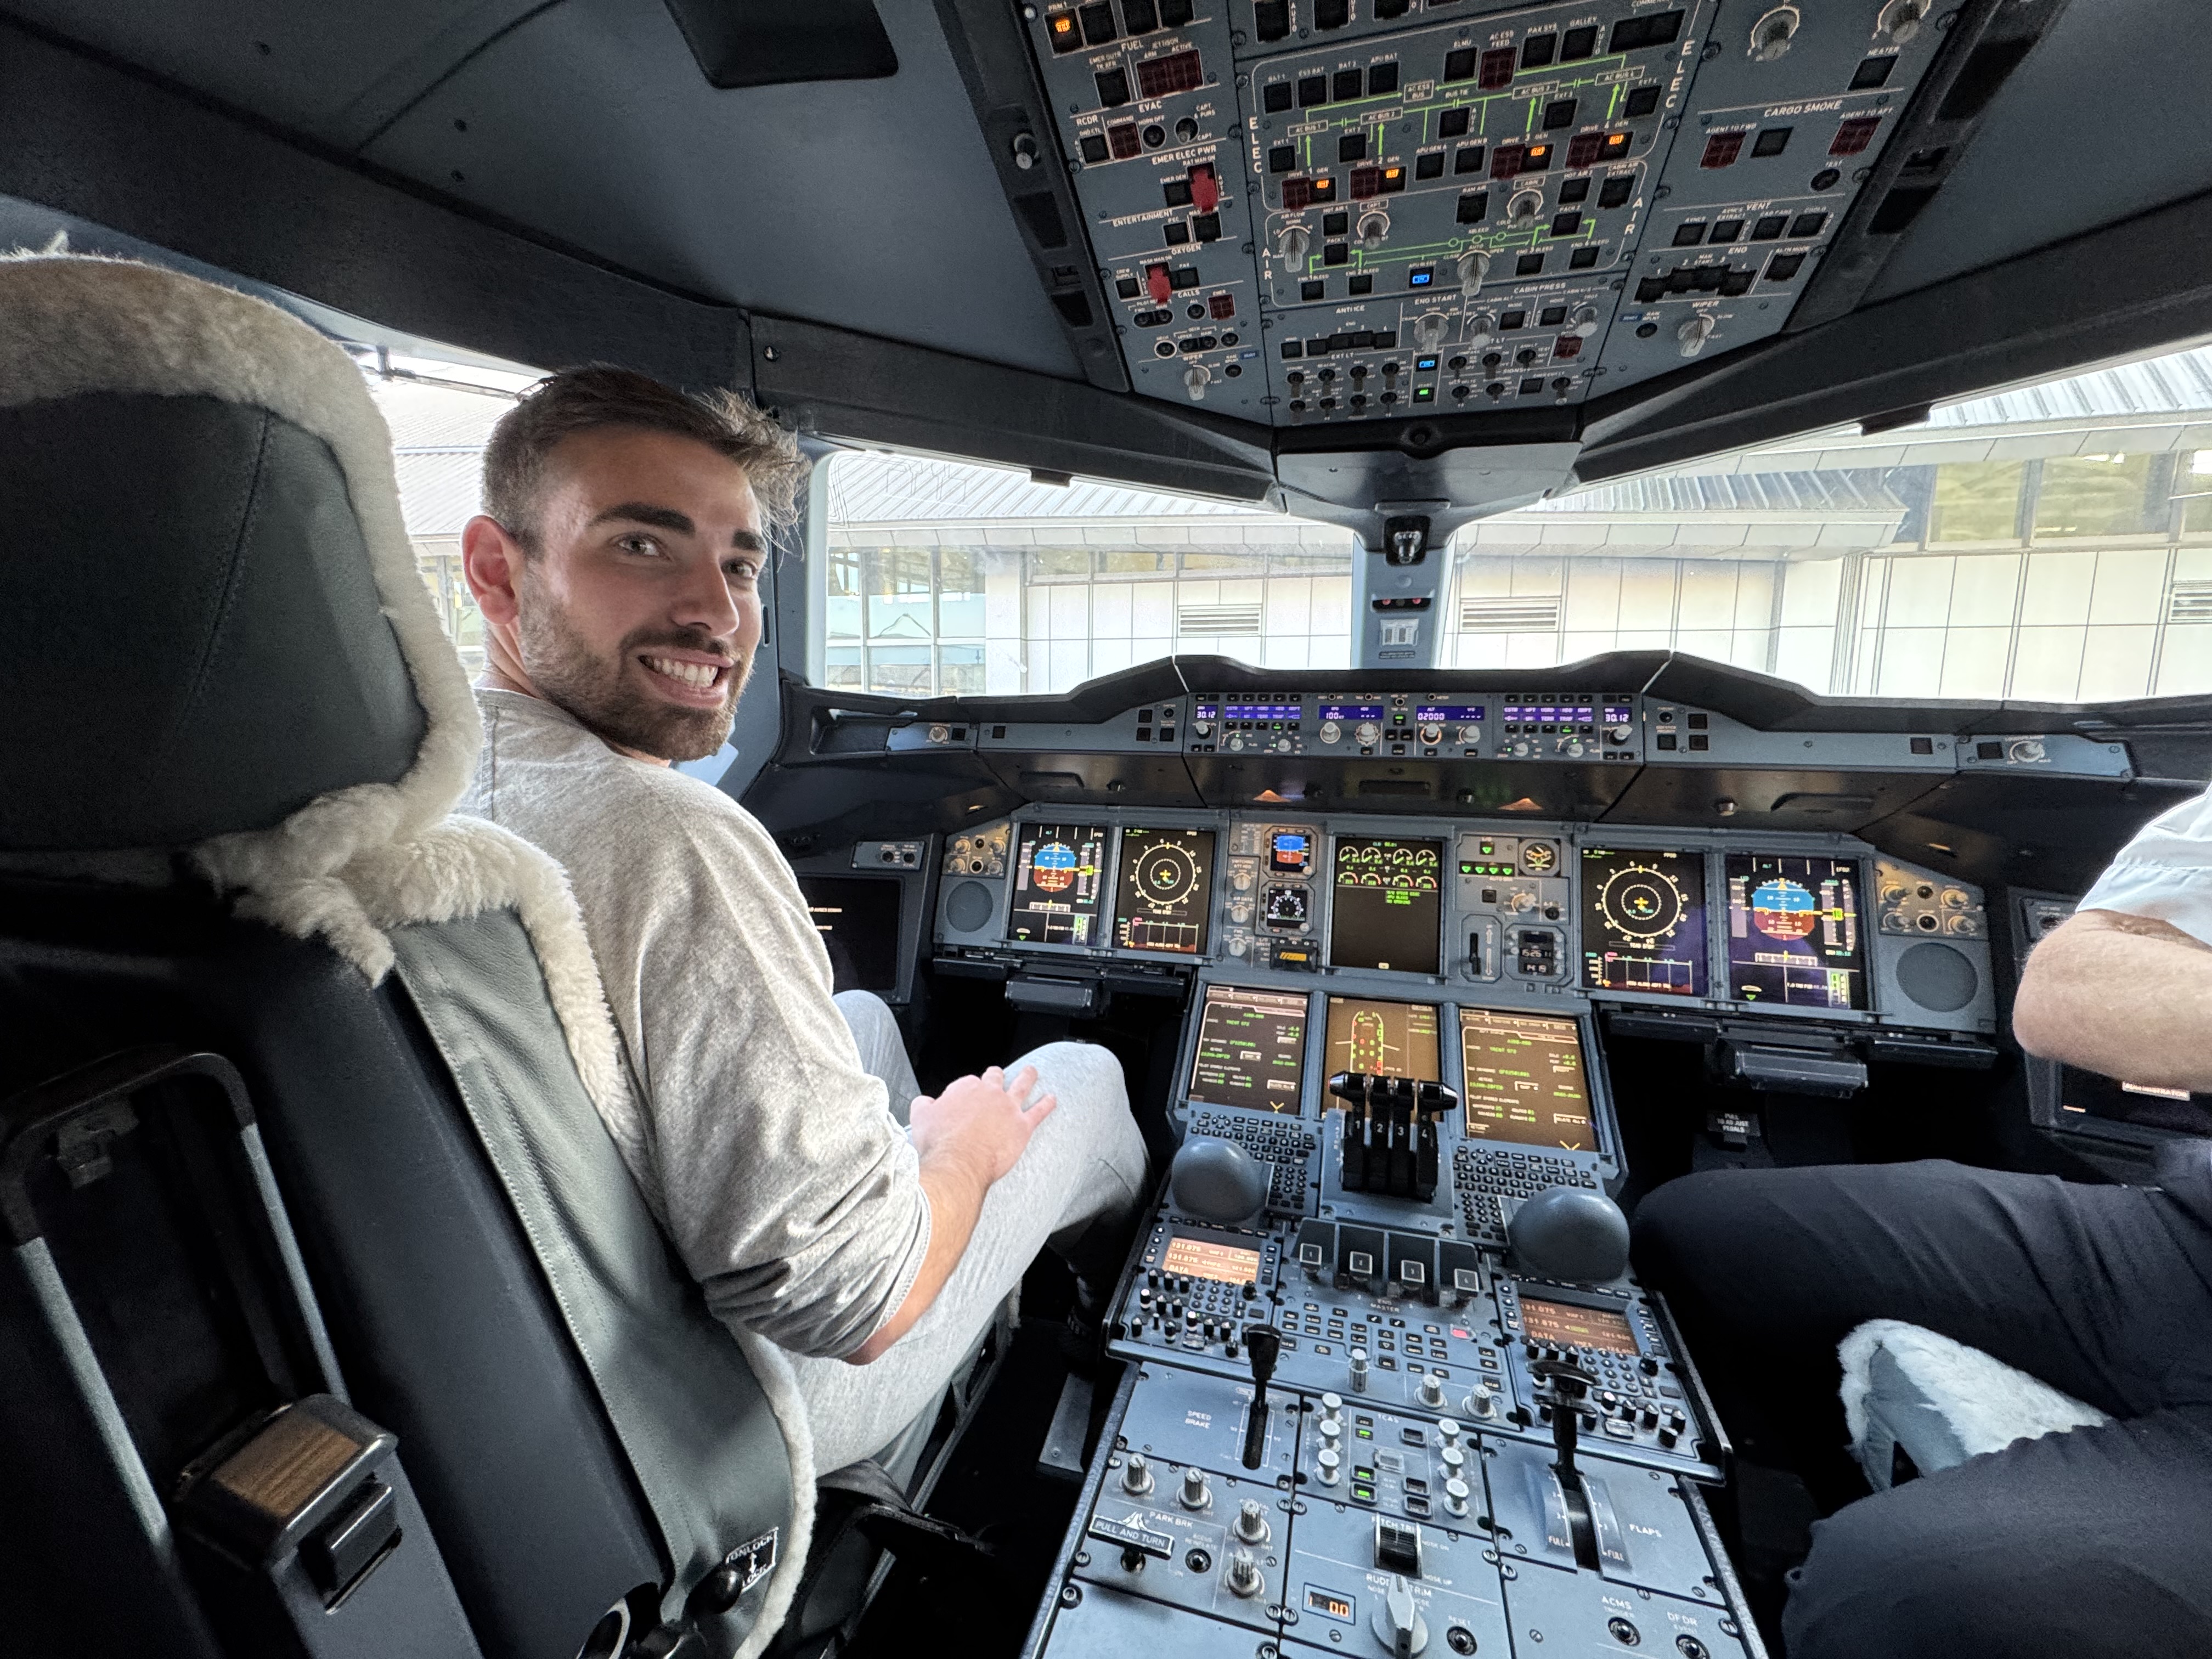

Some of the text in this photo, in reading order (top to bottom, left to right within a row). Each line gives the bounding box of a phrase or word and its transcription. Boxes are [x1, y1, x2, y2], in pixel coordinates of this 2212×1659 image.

[1121, 40, 1144, 52] FUEL
[1666, 40, 1695, 109] ELEC
[1138, 100, 1162, 113] EVAC
[1764, 100, 1842, 118] CARGO SMOKE
[1076, 115, 1098, 126] RCDR
[1107, 115, 1135, 126] COMMAND
[1153, 115, 1165, 123] OFF
[1839, 111, 1866, 119] AGENT
[1249, 116, 1263, 173] ELEC
[1152, 145, 1217, 165] EMER ELEC PWR
[1746, 201, 1771, 211] VENT
[1113, 210, 1173, 227] ENTERTAINMENT
[1624, 197, 1643, 235] AIR
[1171, 245, 1201, 255] OXYGEN
[1728, 246, 1747, 254] ENG
[1262, 247, 1273, 280] AIR
[1514, 283, 1566, 294] CABIN PRESS
[1432, 294, 1457, 303] START
[1336, 306, 1351, 314] ANTI
[1355, 1120, 1360, 1129] 1
[1377, 1124, 1383, 1132] 2
[1398, 1127, 1404, 1136] 3
[1421, 1129, 1427, 1138] 4
[1169, 1265, 1188, 1273] DATA
[1370, 1303, 1400, 1313] MASTER
[1531, 1330, 1555, 1341] DATA
[1187, 1410, 1212, 1421] SPEED
[1378, 1413, 1399, 1423] TCAS
[1185, 1418, 1211, 1429] BRAKE
[1149, 1511, 1194, 1529] PARK BRK
[1095, 1520, 1165, 1548] PULL AND TURN
[1629, 1523, 1662, 1538] FLAPS
[1548, 1536, 1565, 1546] FULL
[730, 1534, 774, 1561] UNLOCK
[1607, 1549, 1624, 1561] FULL
[742, 1563, 768, 1588] LOCK
[1409, 1584, 1432, 1596] TRIM
[1601, 1596, 1632, 1610] ACMS
[1448, 1615, 1470, 1626] RESET
[1667, 1611, 1697, 1627] DFDR
